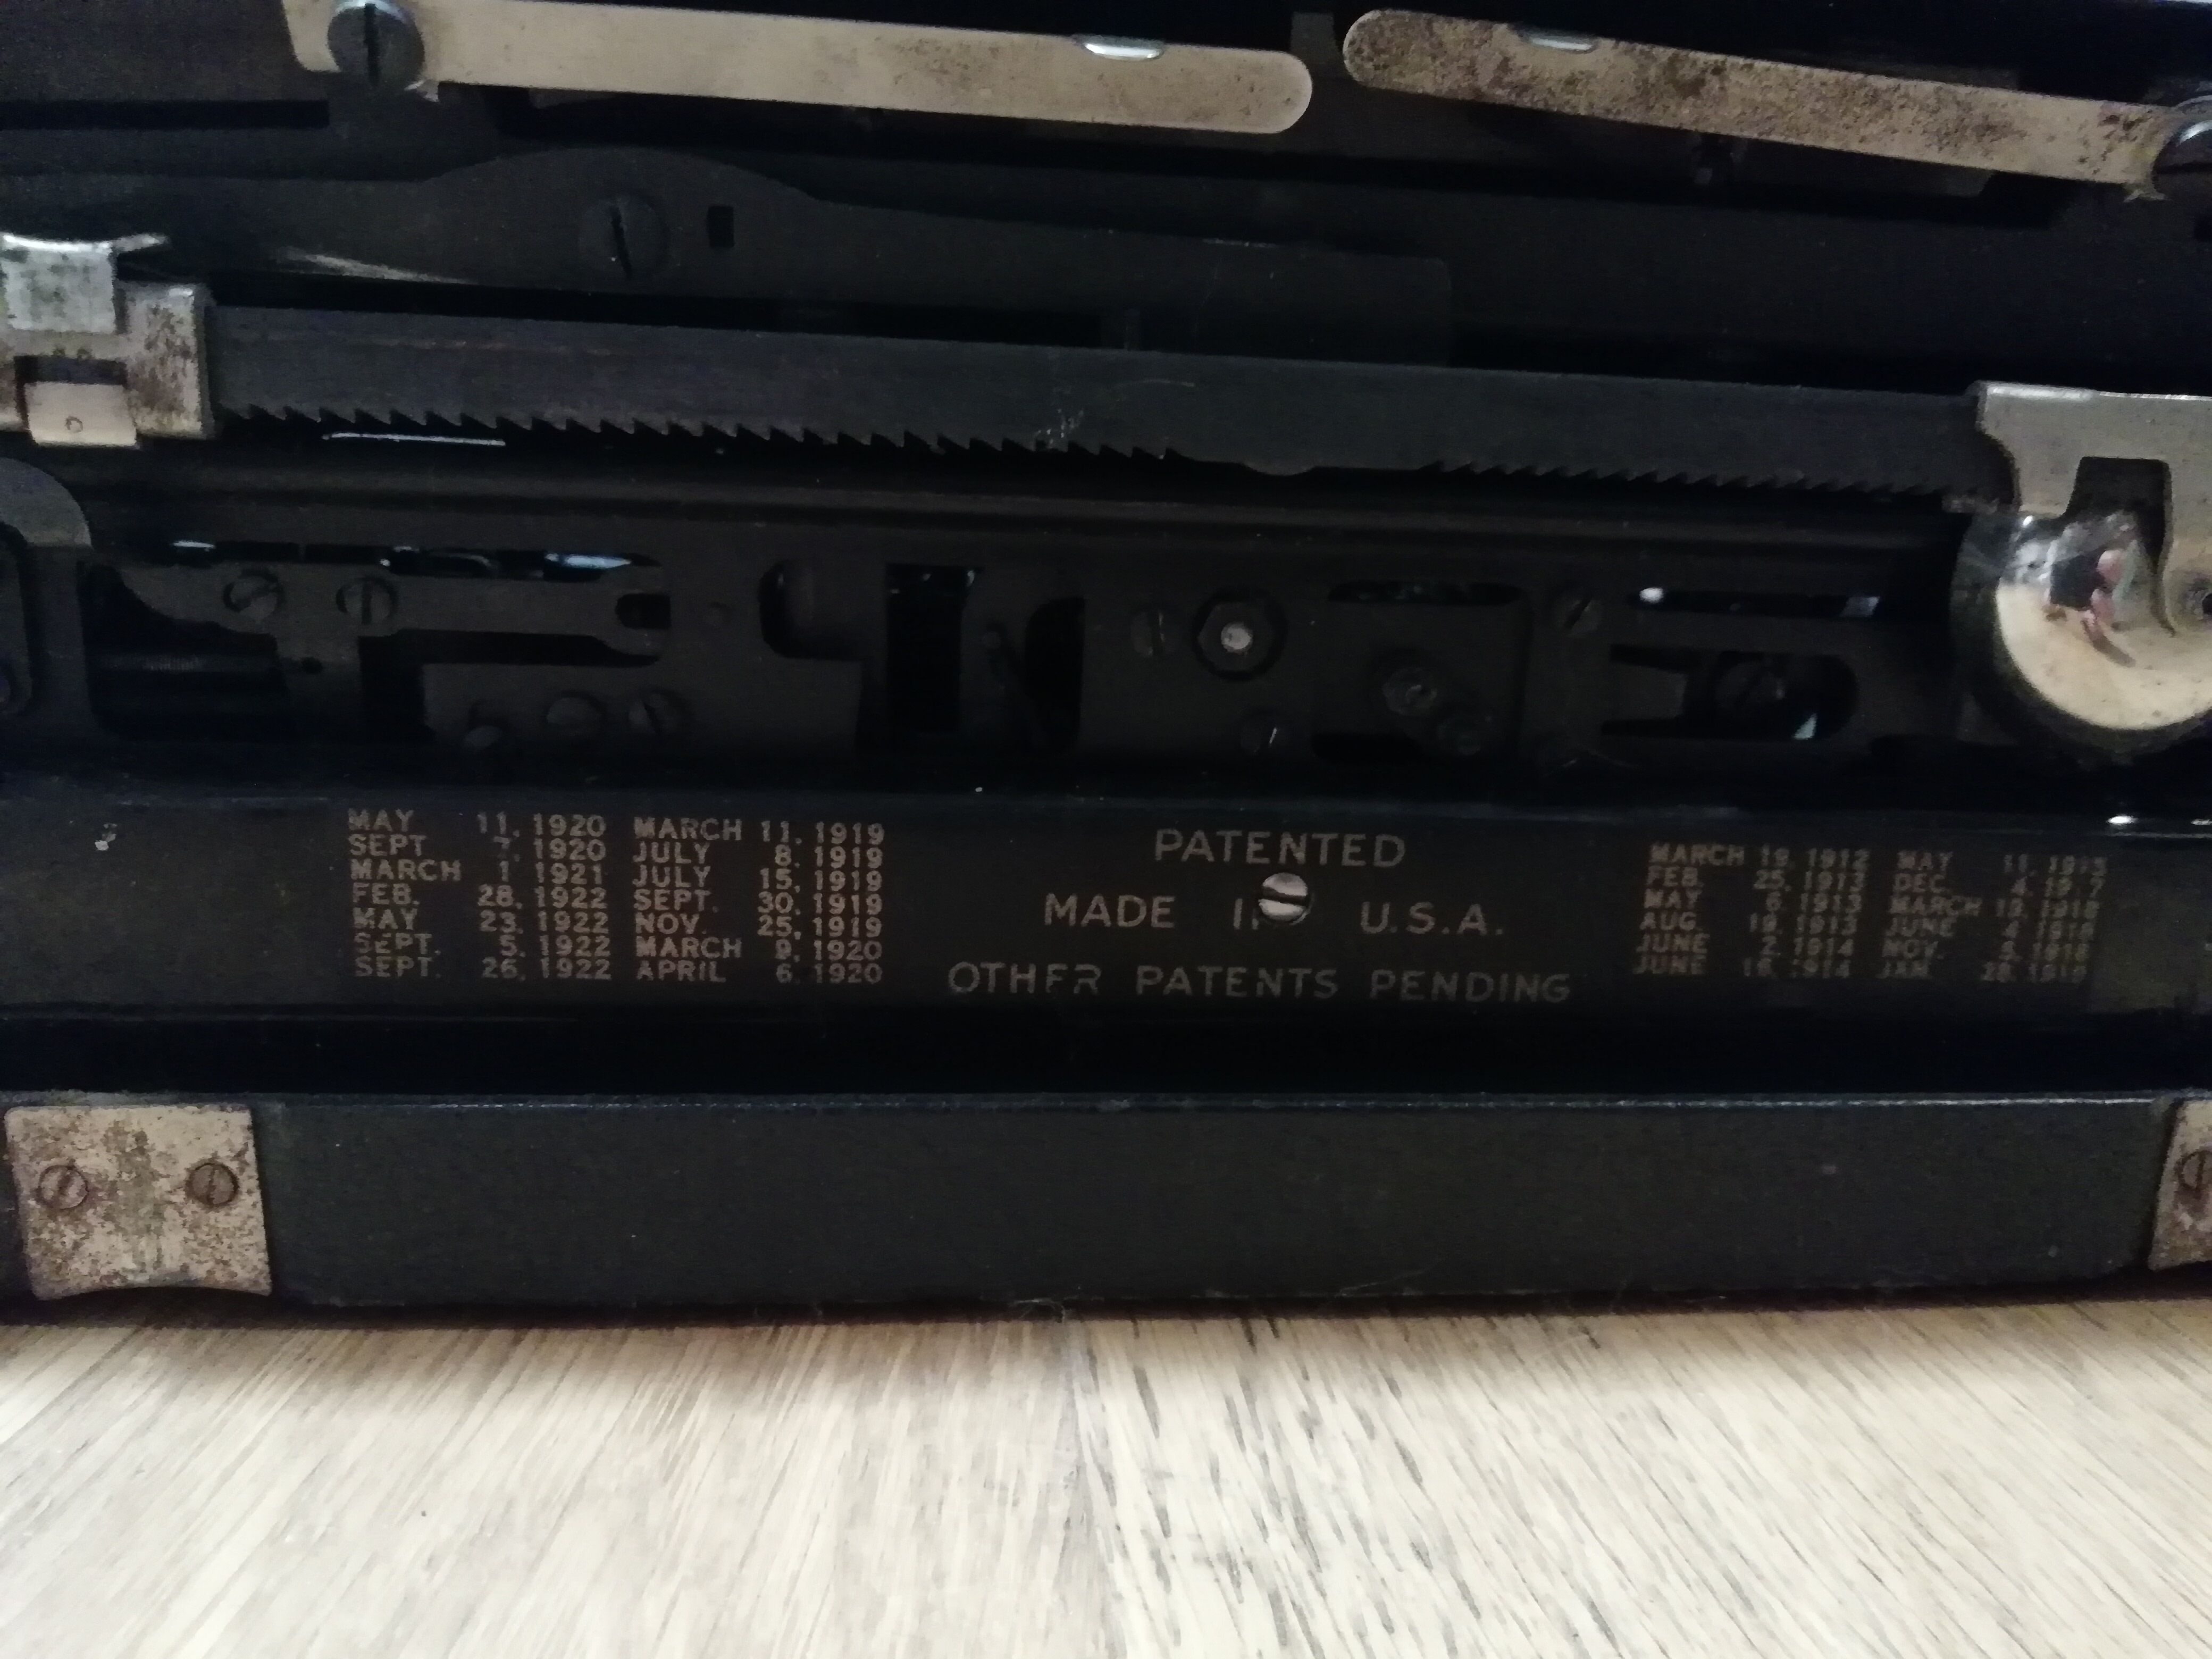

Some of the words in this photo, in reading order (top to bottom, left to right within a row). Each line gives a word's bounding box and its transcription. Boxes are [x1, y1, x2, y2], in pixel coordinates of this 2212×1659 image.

[348, 808, 414, 832] MAY
[534, 813, 606, 837] 1920
[634, 817, 742, 841] MARCH
[816, 821, 885, 845] 1919
[348, 834, 426, 856] SEPT
[534, 838, 607, 861] 1920
[633, 841, 710, 865] JULY
[815, 846, 883, 869] 1919
[1155, 828, 1406, 868] PATENTED
[1649, 843, 1745, 866] MARCH
[350, 859, 462, 881] MARCH
[535, 862, 602, 884] 1921
[632, 865, 711, 887] JULY
[814, 870, 883, 892] 1919
[353, 883, 420, 906] FEB.
[534, 886, 607, 909] 1922
[813, 893, 883, 915] 1919
[1644, 888, 1703, 909] MAY
[353, 907, 417, 931] MAY
[538, 910, 609, 934] 1922
[812, 916, 882, 937] 1919
[1043, 893, 1176, 929] MADE
[1361, 899, 1504, 937] U.S.A.
[539, 935, 611, 957] 1922
[635, 936, 742, 958] MARCH
[813, 940, 883, 961] 1920
[1636, 933, 1711, 953] JUNE
[540, 958, 612, 980] 1922
[637, 960, 727, 983] APRIL
[814, 963, 883, 984] 1920
[1136, 964, 1339, 1000] PATENTS
[1370, 969, 1570, 1005] PENDING
